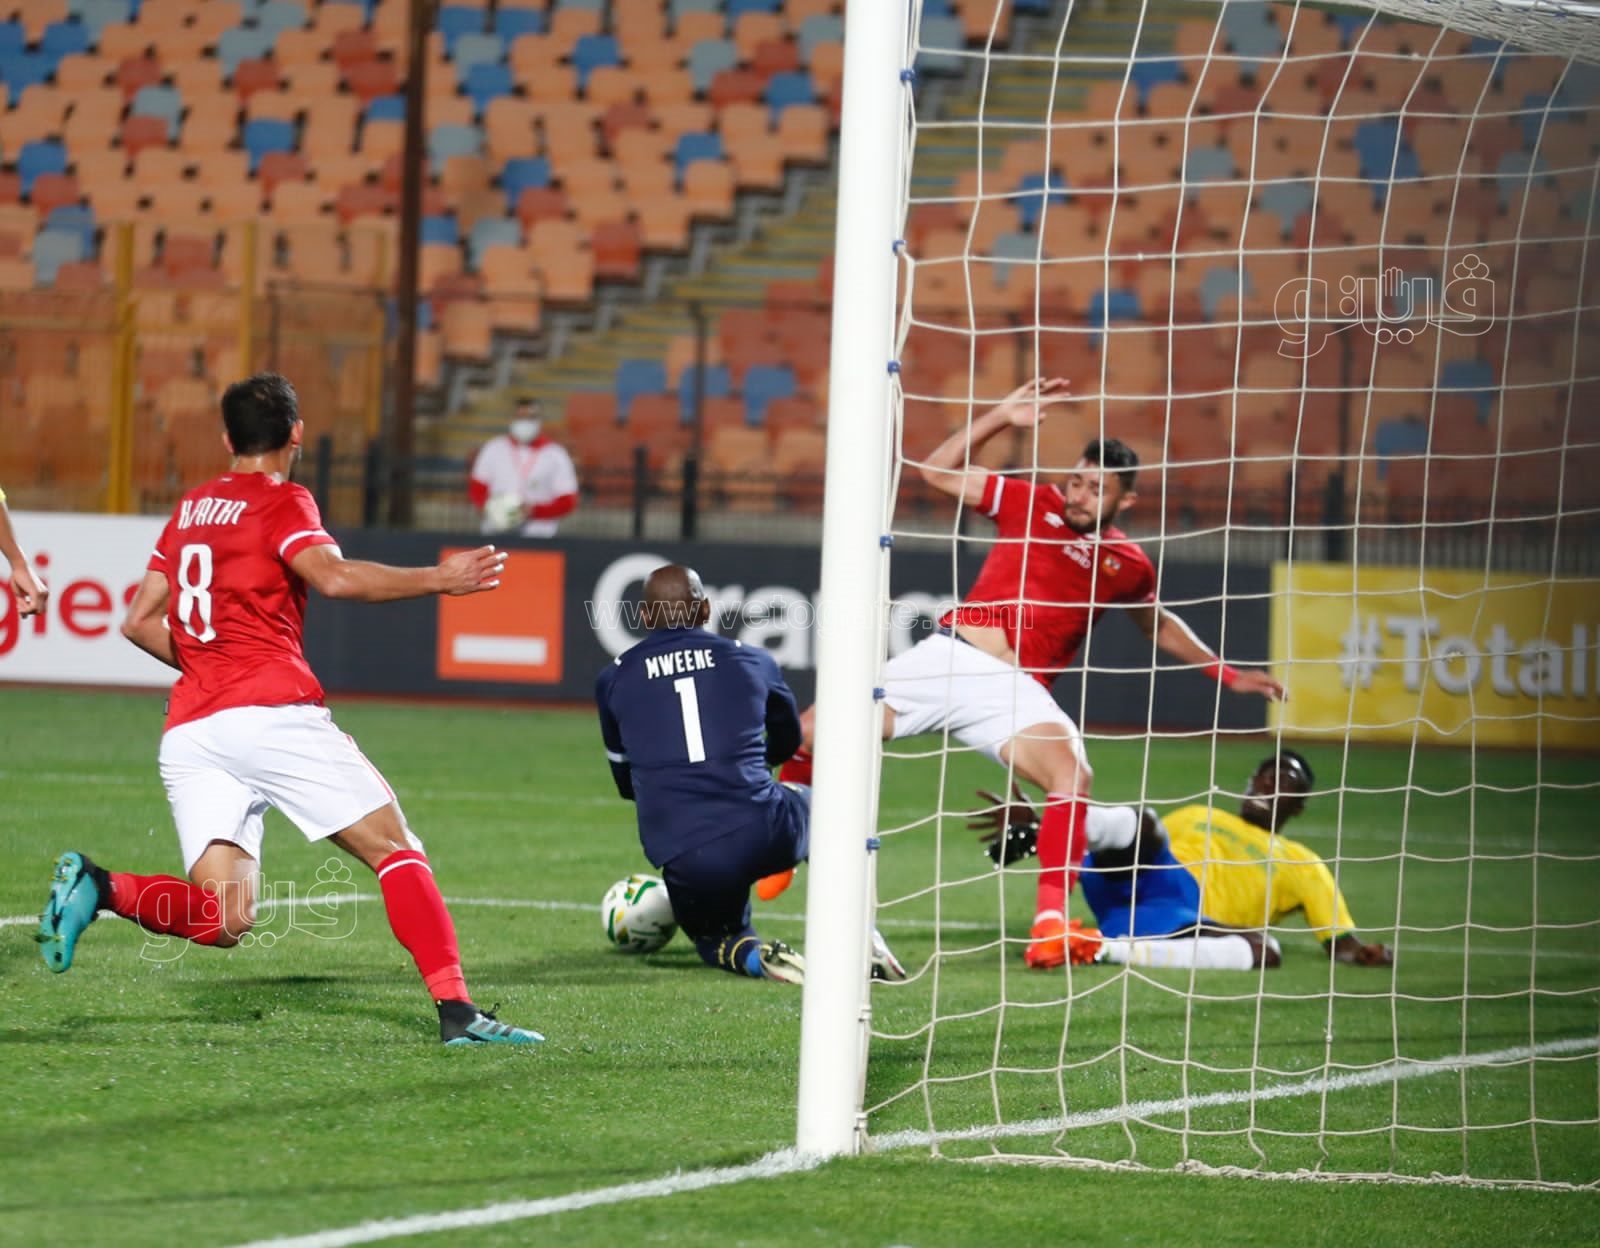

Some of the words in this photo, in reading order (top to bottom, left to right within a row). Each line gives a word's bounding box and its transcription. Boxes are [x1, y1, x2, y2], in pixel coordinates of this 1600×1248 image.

[177, 543, 217, 644] 8
[645, 649, 716, 680] MWEENE
[1338, 615, 1600, 697] #Total
[673, 676, 706, 764] 1
